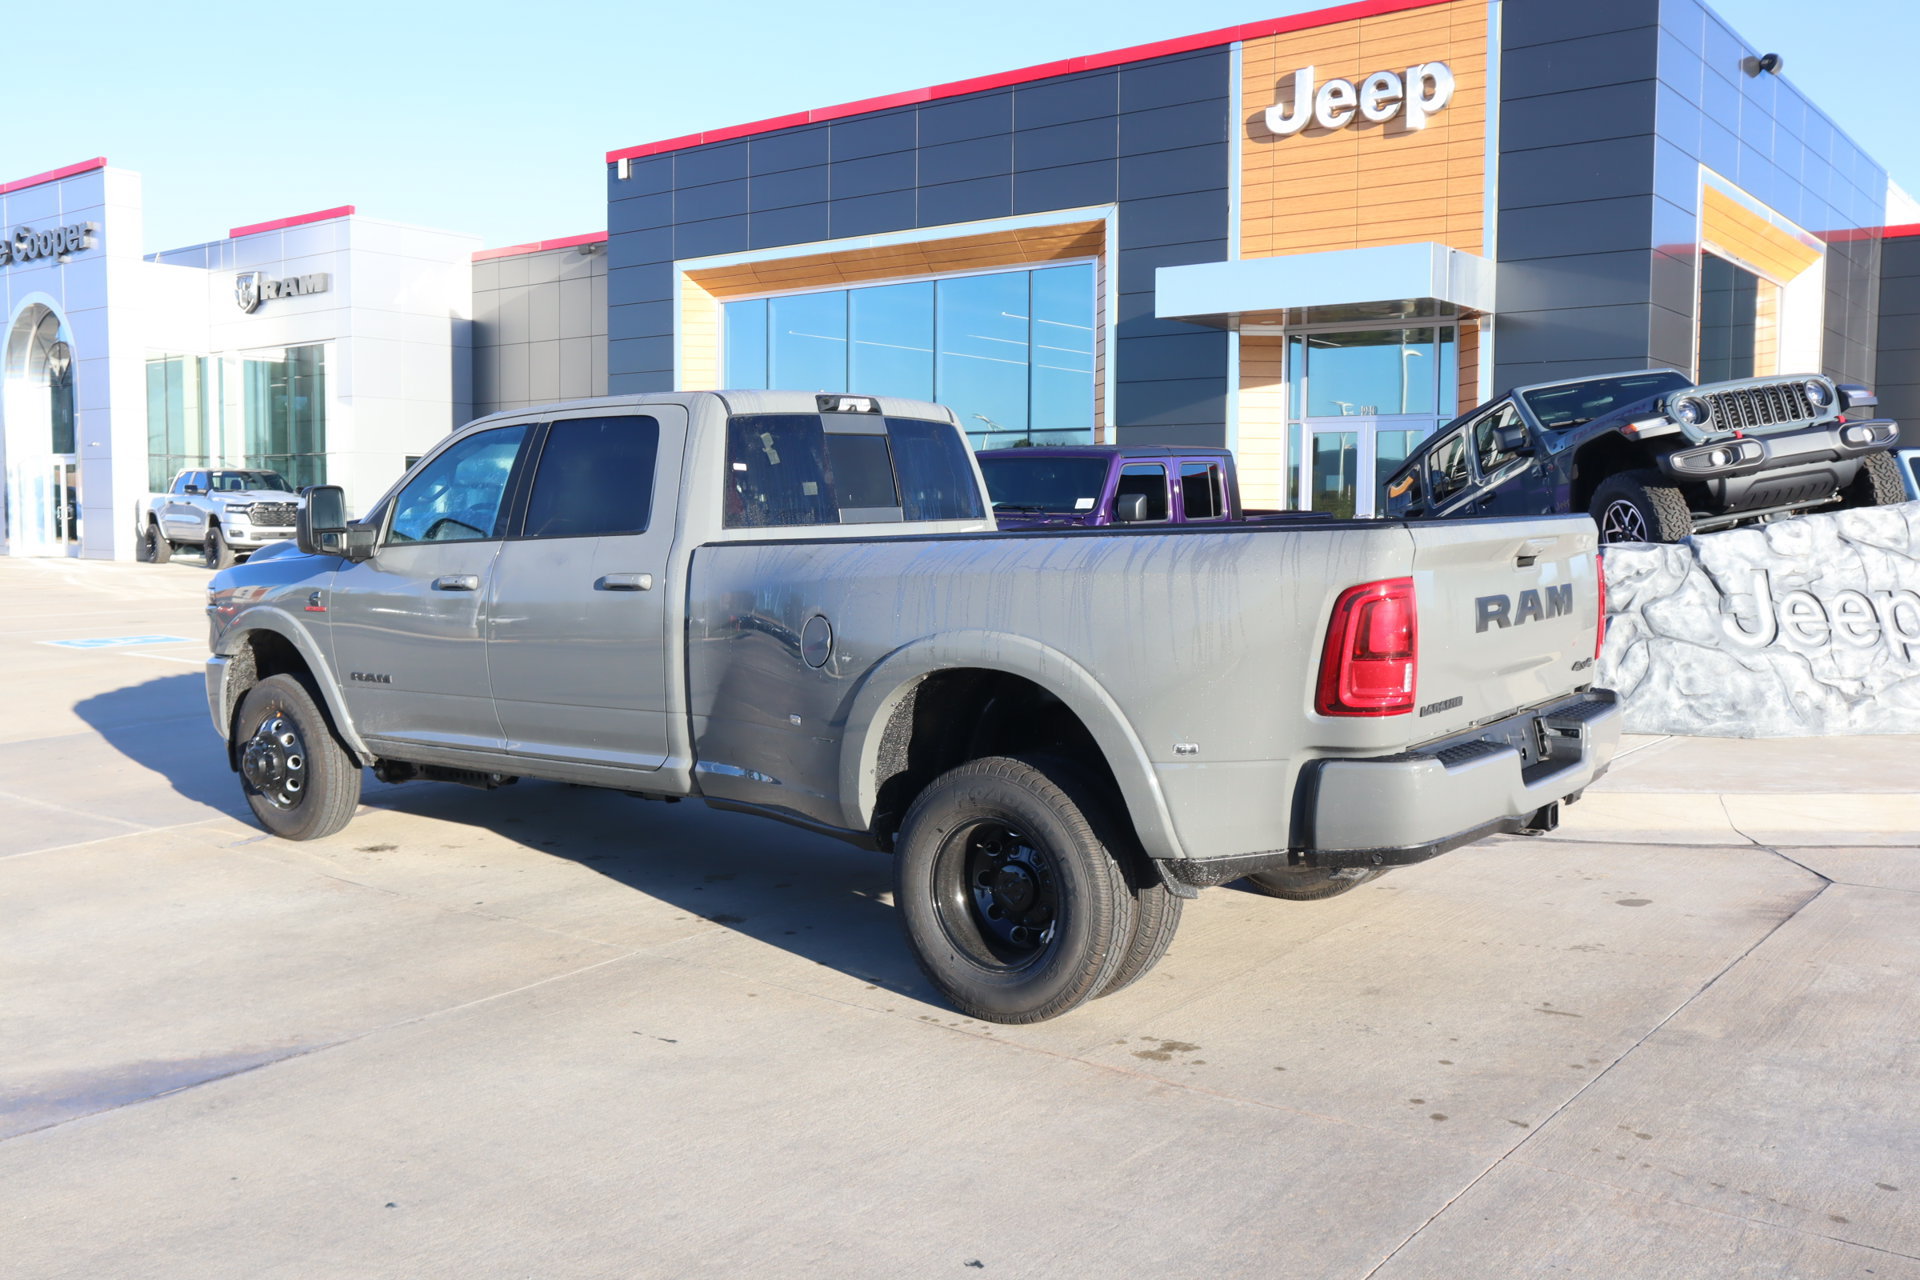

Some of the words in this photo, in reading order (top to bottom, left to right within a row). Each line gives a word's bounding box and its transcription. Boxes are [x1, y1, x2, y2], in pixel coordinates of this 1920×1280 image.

[1265, 61, 1455, 134] Jeep
[11, 222, 96, 267] Cooper
[260, 273, 328, 300] RAM
[1475, 583, 1573, 633] RAM
[1719, 569, 1920, 664] Jeep
[351, 672, 392, 684] RAM
